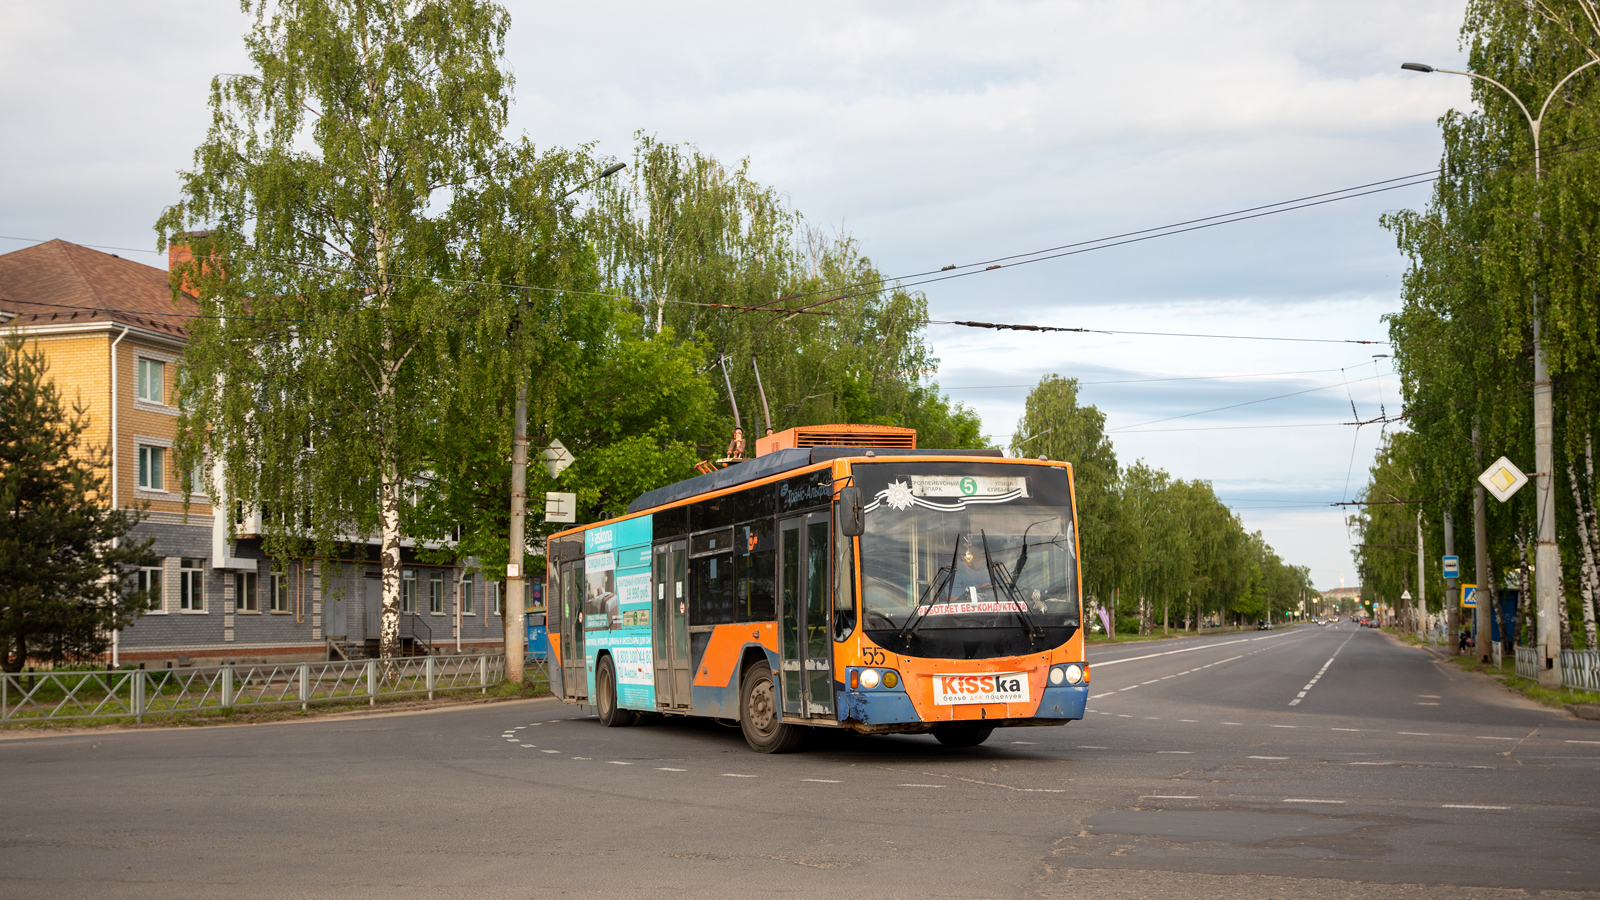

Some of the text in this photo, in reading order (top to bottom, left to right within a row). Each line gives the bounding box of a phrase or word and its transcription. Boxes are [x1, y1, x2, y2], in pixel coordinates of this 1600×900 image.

[963, 479, 974, 494] 5
[594, 527, 613, 545] askona
[918, 604, 959, 616] РАБОТАЕТ
[977, 602, 1027, 612] КОНДУКТОРА
[862, 647, 886, 666] 55
[943, 694, 967, 702] белье
